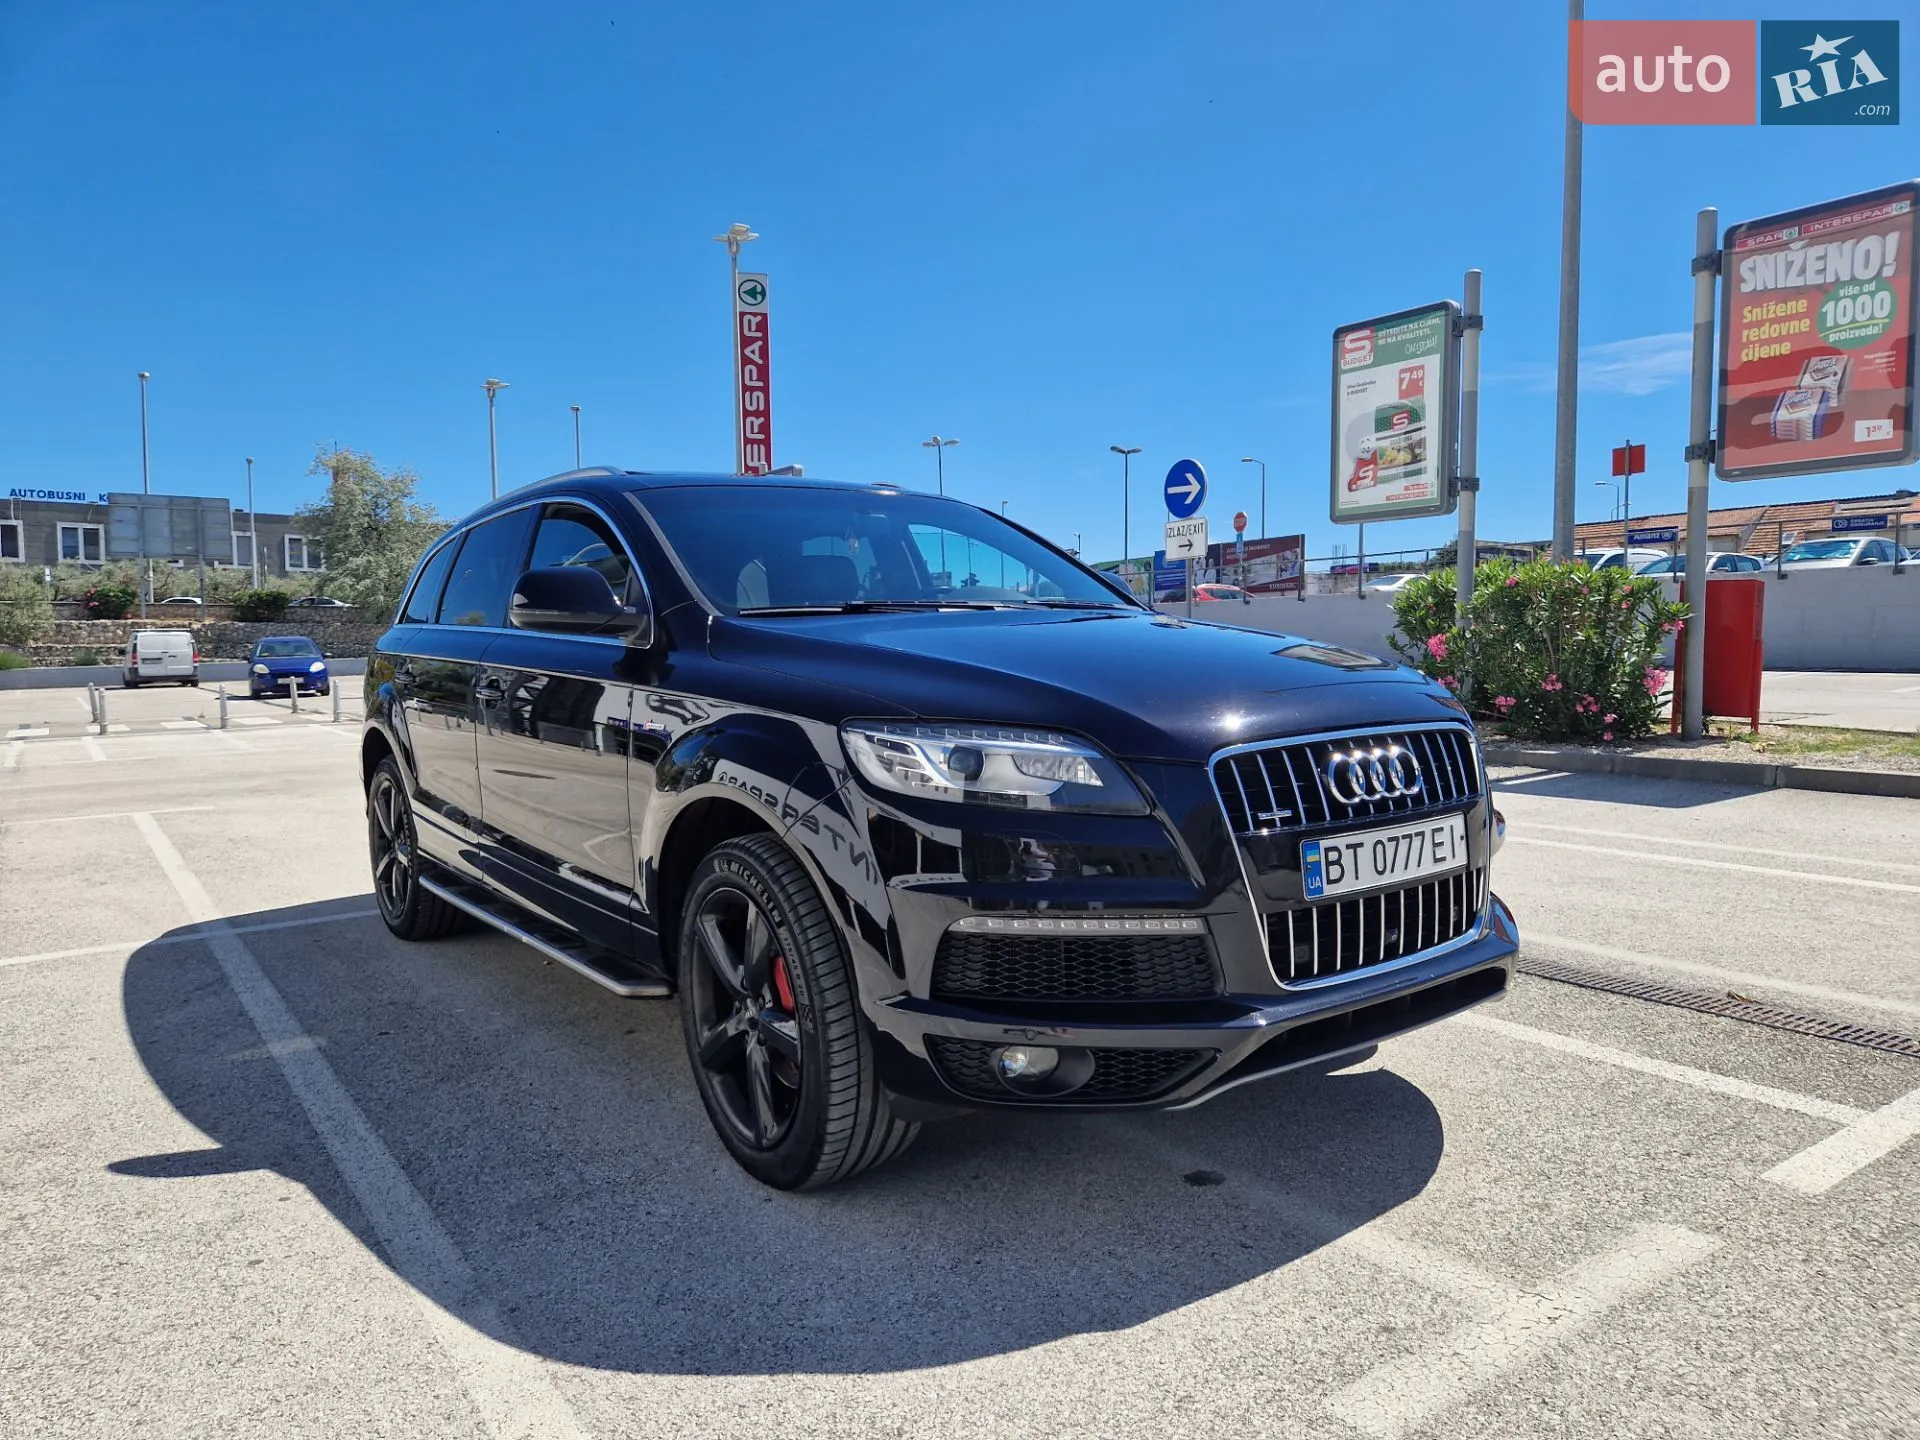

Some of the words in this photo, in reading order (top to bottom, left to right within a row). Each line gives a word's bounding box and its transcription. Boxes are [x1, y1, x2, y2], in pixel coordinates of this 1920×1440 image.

[1810, 206, 1893, 231] INTERSPAR
[1746, 233, 1784, 247] SPAR
[1739, 231, 1901, 293] SNIŽENO!
[1839, 284, 1860, 297] više
[1862, 280, 1876, 293] od
[1742, 298, 1809, 323] Snižene
[1821, 290, 1892, 328] 1000
[1742, 318, 1811, 343] redovne
[1829, 324, 1883, 343] proizvoda!
[1345, 330, 1371, 359] S
[1741, 341, 1791, 362] cijene
[1342, 354, 1373, 367] BUDGET
[743, 314, 766, 476] ERSPAR
[9, 488, 86, 501] AUTOBUSNI
[98, 493, 109, 503] K
[1167, 522, 1204, 538] IZLAZ/EXIT
[1633, 531, 1660, 541] Allianz
[1323, 842, 1365, 886] BT
[1373, 830, 1427, 876] 0777
[1431, 824, 1457, 864] EI
[730, 861, 783, 924] MICHELIN
[1308, 875, 1323, 889] UA
